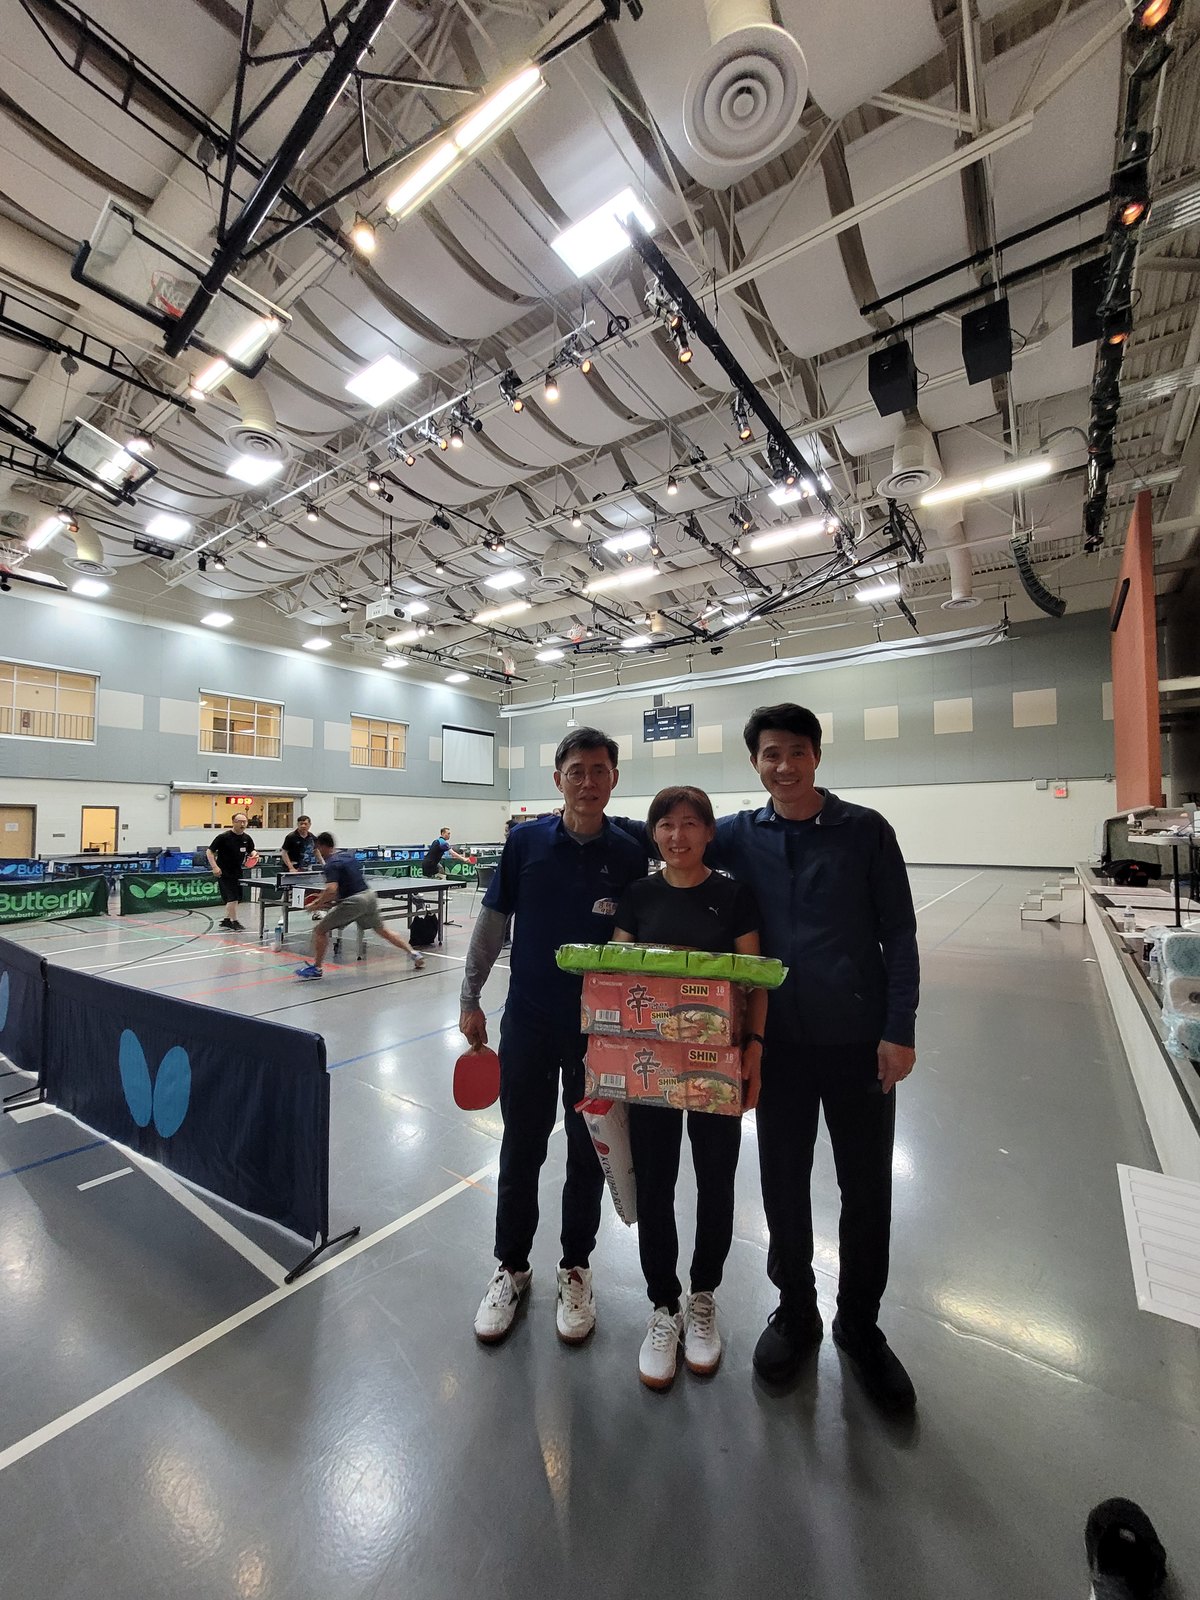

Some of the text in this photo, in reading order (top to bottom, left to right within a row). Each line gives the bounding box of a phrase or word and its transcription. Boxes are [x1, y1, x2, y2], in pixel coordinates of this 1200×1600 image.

[166, 880, 219, 897] Butter
[0, 889, 95, 912] Butterfly
[681, 984, 708, 996] SHIN
[626, 983, 655, 1025] 辛
[689, 1050, 717, 1062] SHIN
[632, 1047, 662, 1092] 辛
[658, 1078, 677, 1086] SHIN
